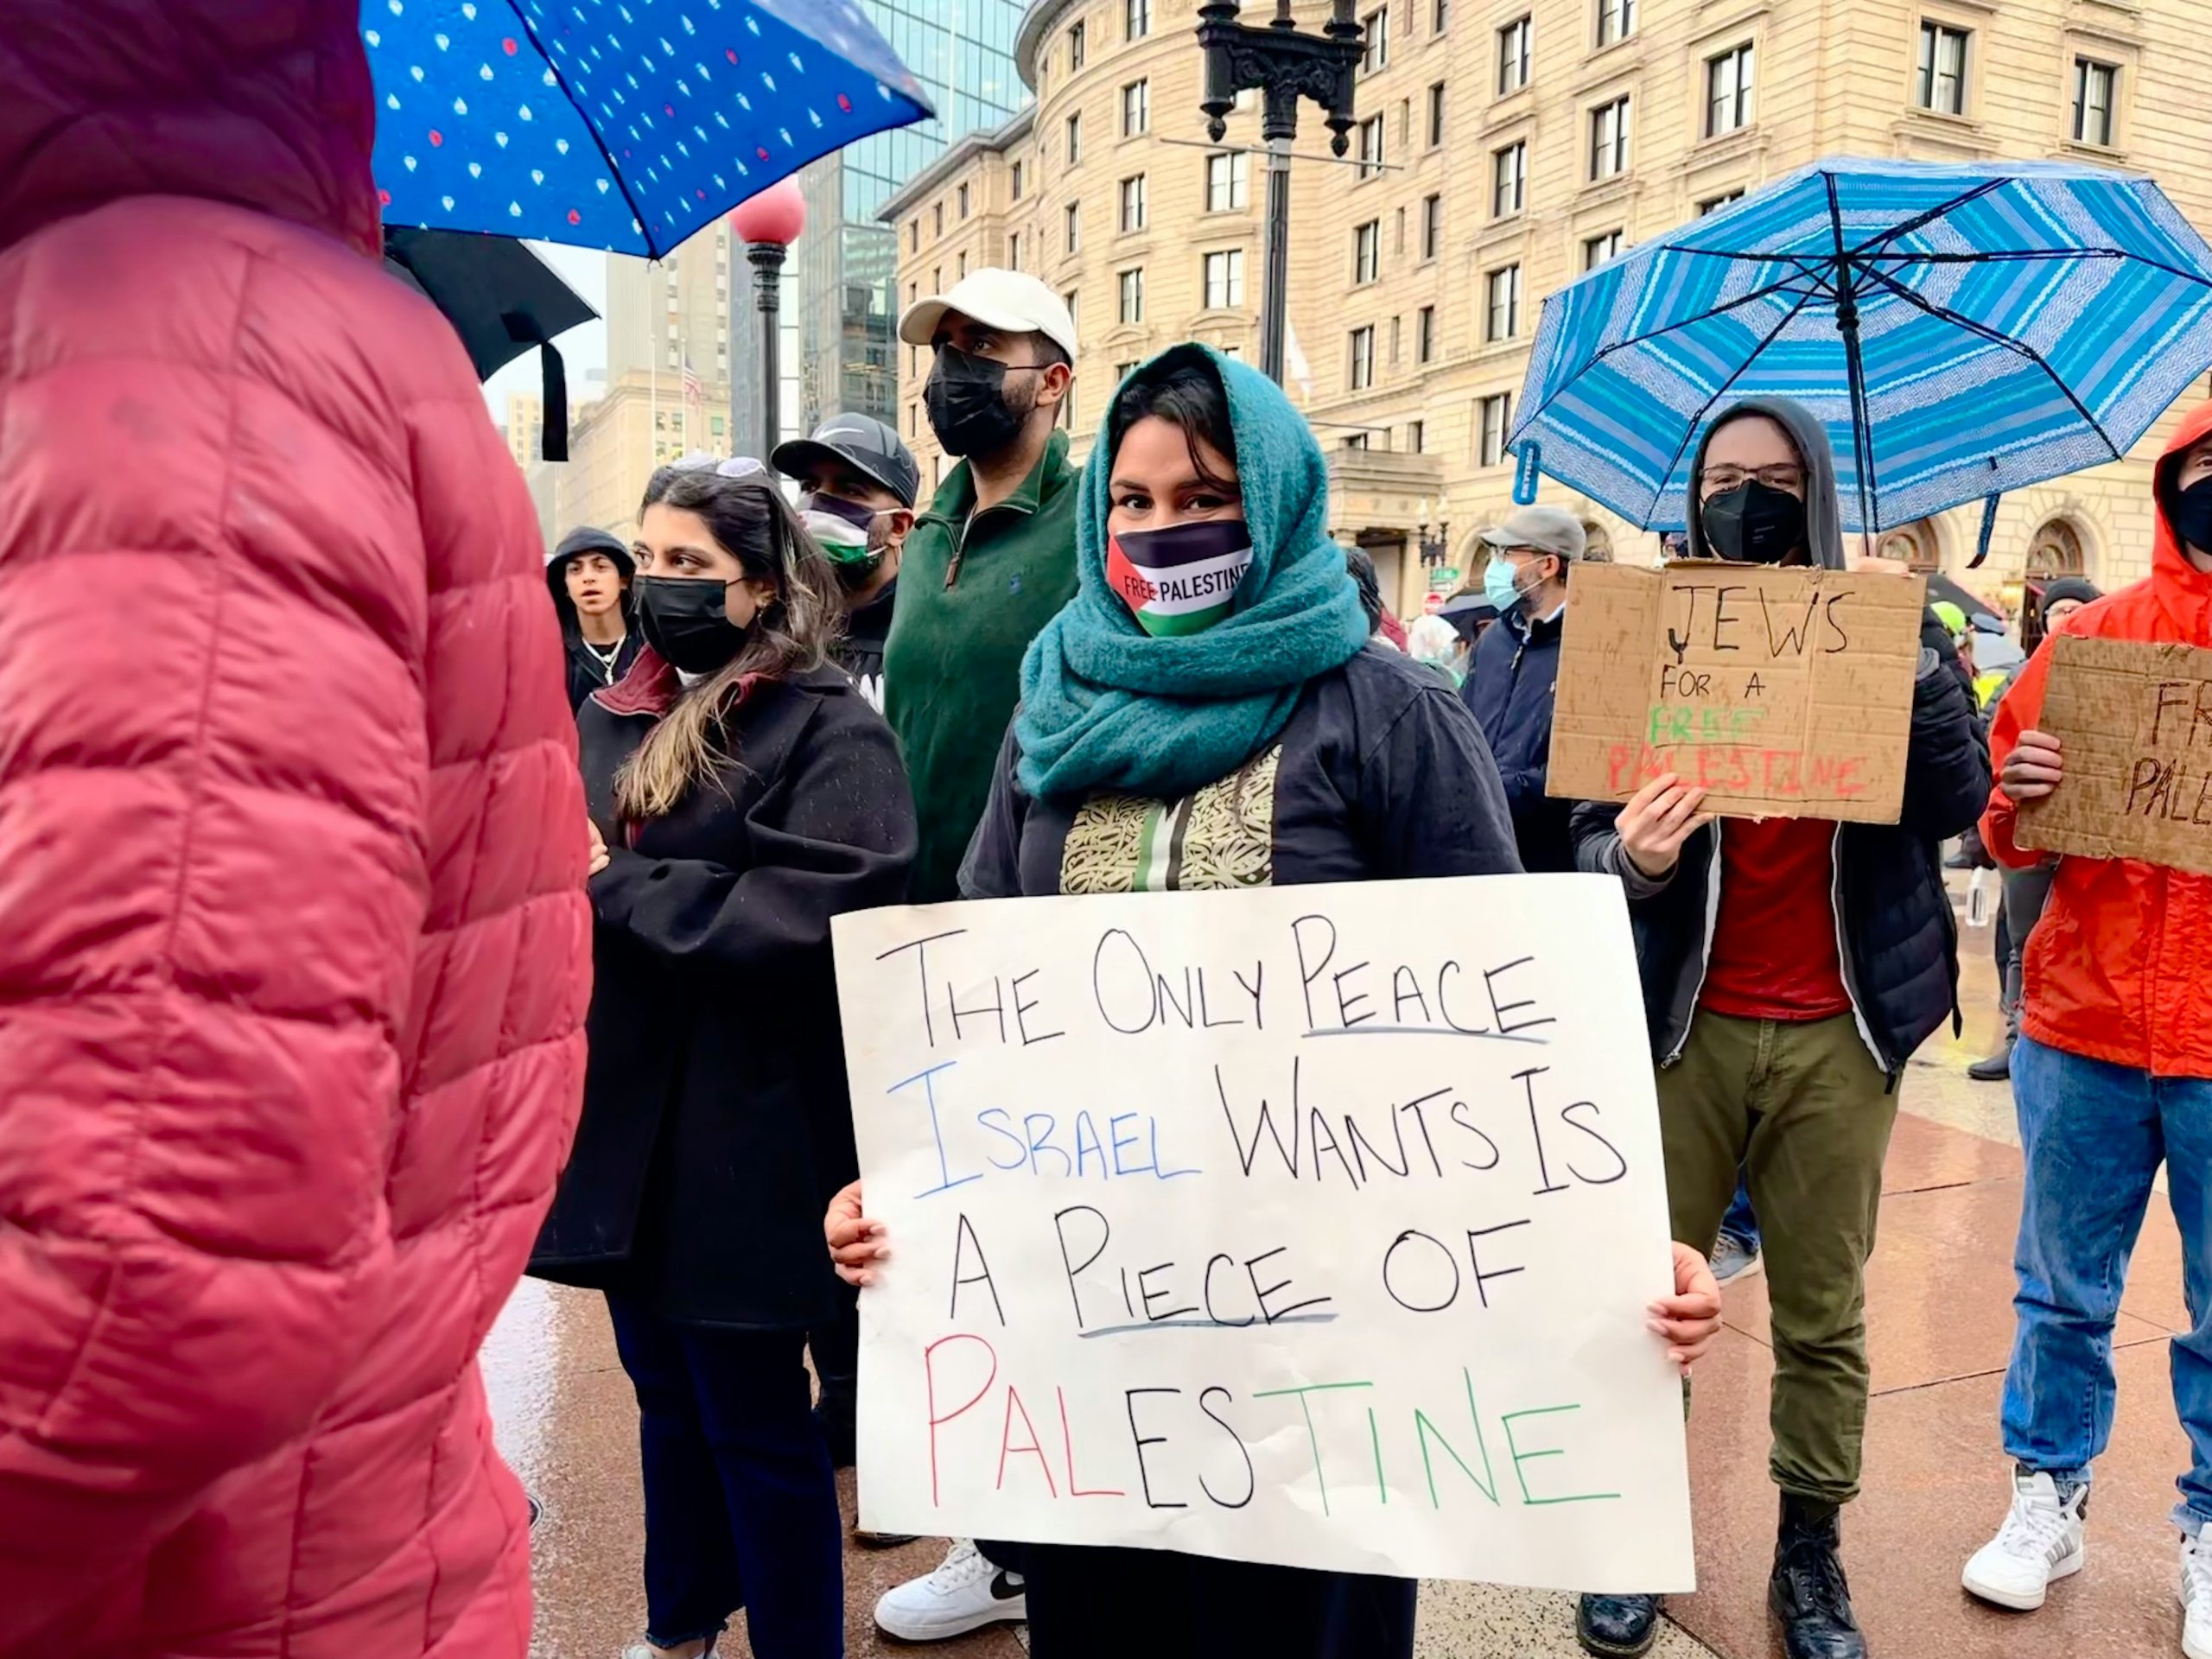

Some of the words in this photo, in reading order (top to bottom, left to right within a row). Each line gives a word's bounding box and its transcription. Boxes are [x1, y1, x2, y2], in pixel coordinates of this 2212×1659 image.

[1124, 575, 1156, 601] FREE
[1667, 585, 1856, 664] JEWS
[1660, 664, 1711, 698] FOR
[1745, 671, 1766, 698] A
[1649, 705, 1768, 745] FREE
[1608, 741, 1872, 796] PALESTINE
[875, 929, 1065, 1047] THE
[1093, 928, 1262, 1034] ONLY
[1290, 914, 1557, 1034] PEACE
[886, 1060, 1203, 1199] ISRAEL
[1214, 1056, 1501, 1191] WANTS
[1510, 1065, 1629, 1195] IS
[950, 1212, 1006, 1327] A
[1053, 1205, 1332, 1329] PIECE
[1382, 1219, 1531, 1313] OF
[924, 1334, 1622, 1517] PALESTINE
